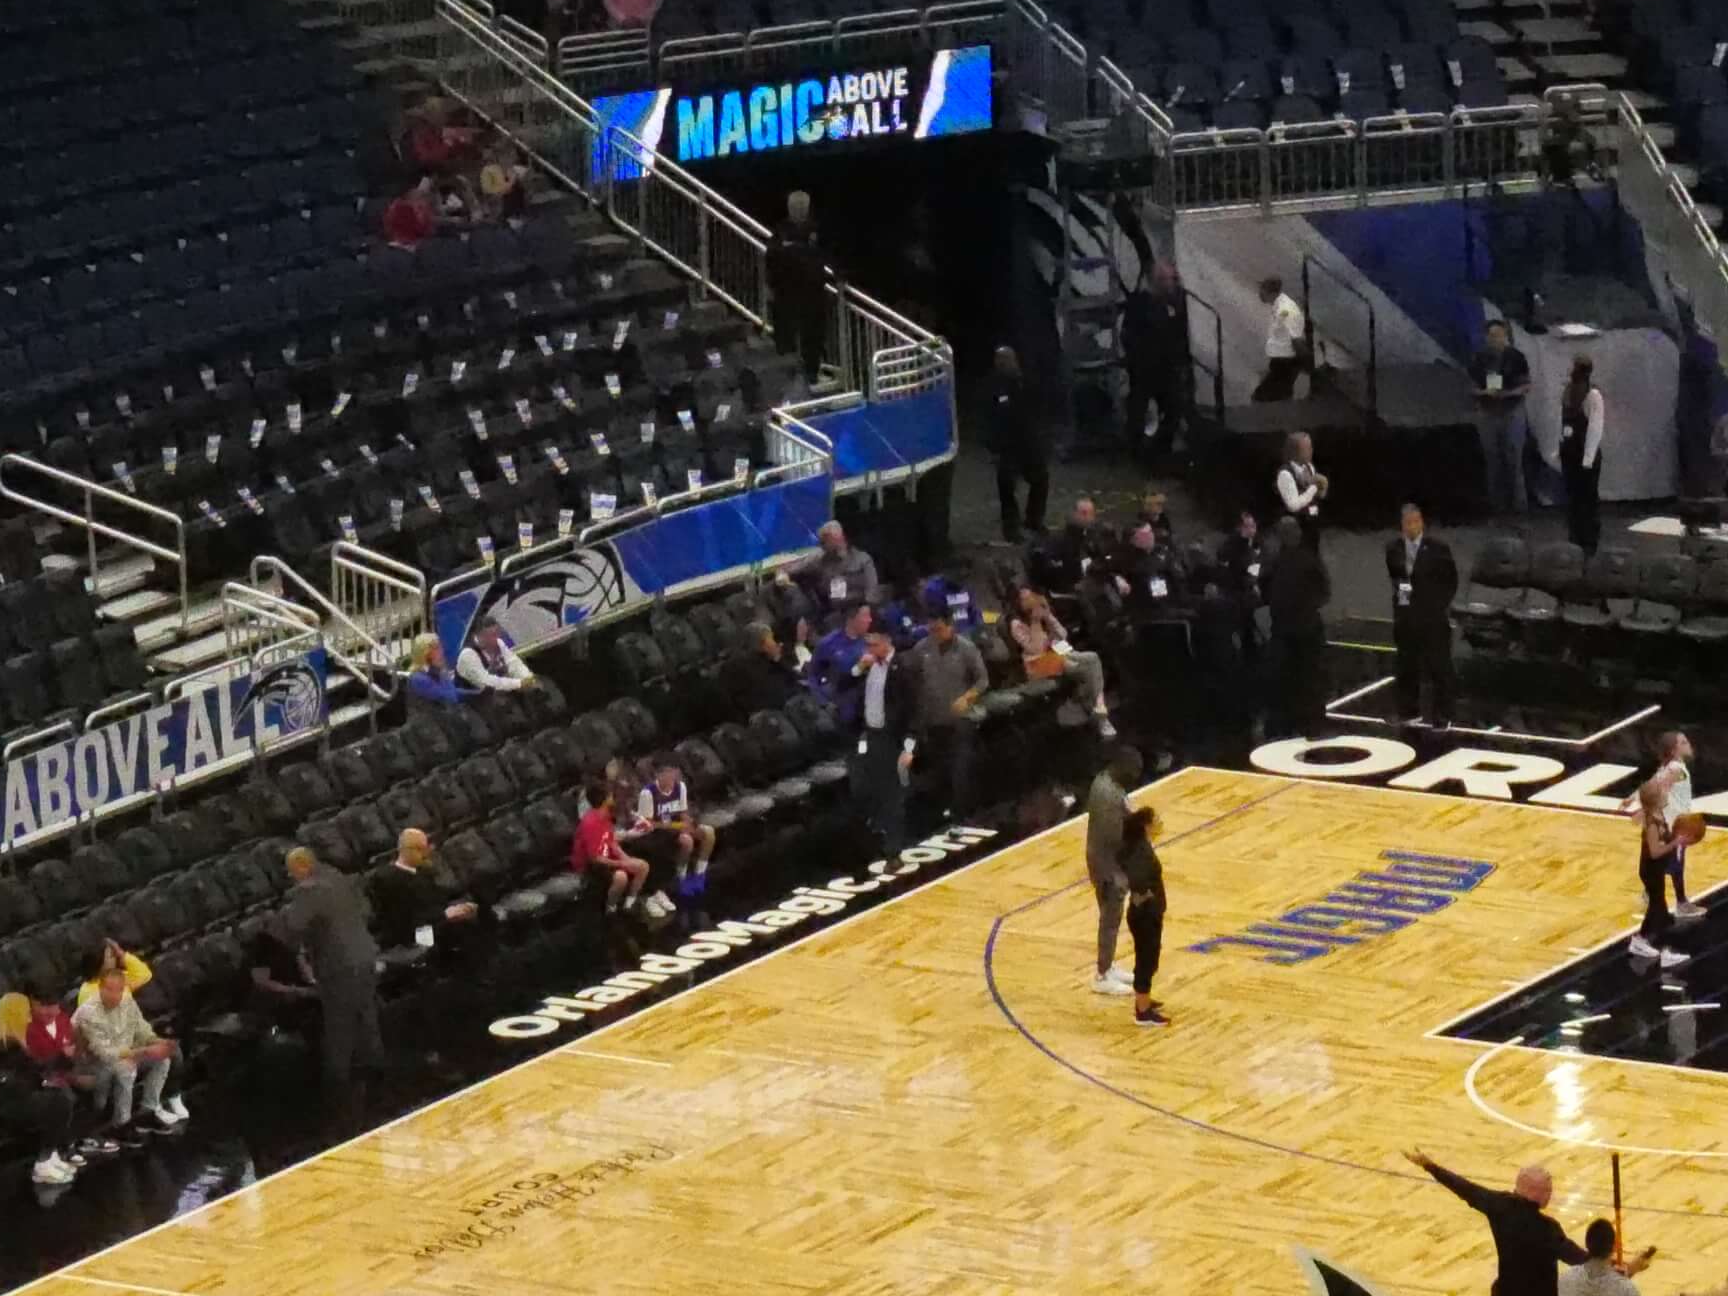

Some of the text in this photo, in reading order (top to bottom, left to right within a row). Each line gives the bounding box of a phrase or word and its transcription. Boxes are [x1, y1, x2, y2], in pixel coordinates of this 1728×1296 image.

[826, 67, 910, 104] ABOVE
[677, 78, 828, 162] MAGIC
[849, 99, 908, 140] ALL
[3, 704, 177, 845] ABOVE
[184, 674, 281, 773] ALL
[488, 823, 1000, 1041] OrlandoMagic.com
[459, 1171, 560, 1217] COURT
